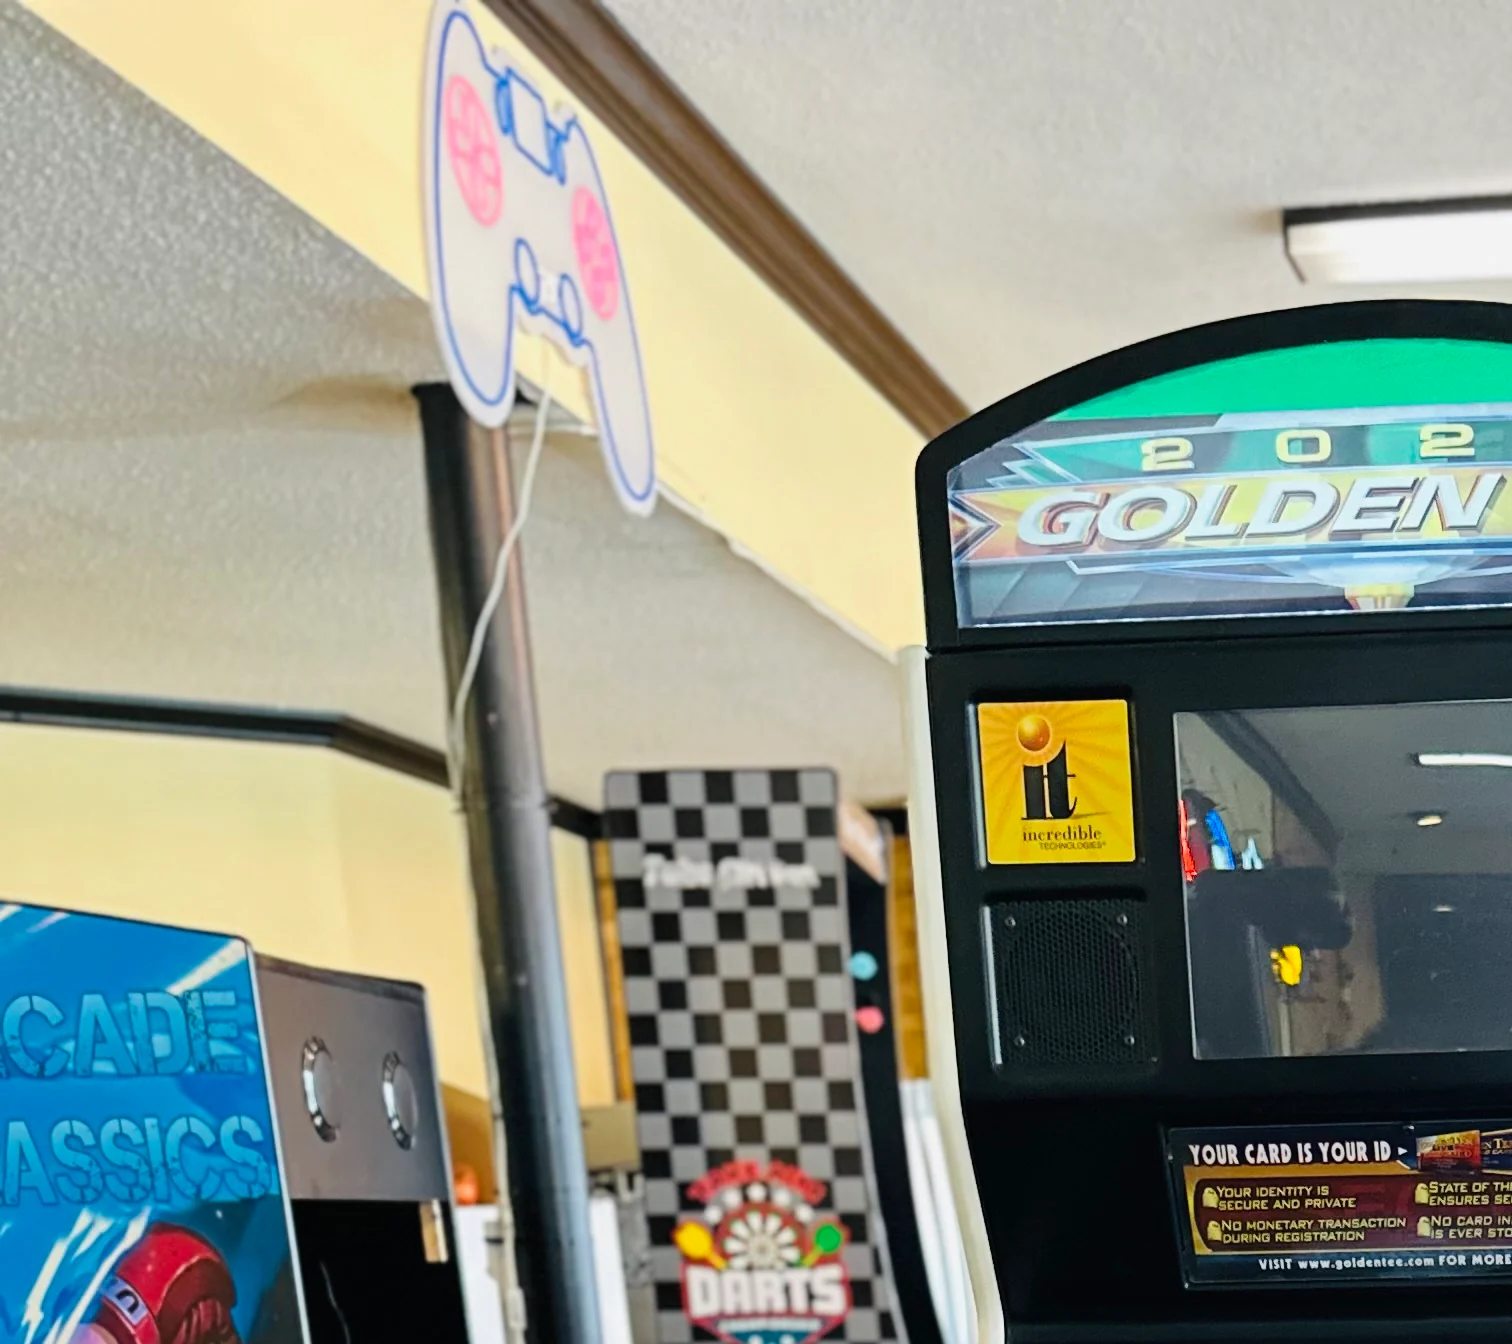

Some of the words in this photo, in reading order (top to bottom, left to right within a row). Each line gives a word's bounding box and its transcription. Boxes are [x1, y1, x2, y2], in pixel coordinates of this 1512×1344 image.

[1017, 471, 1512, 550] GOLDEN
[1023, 825, 1102, 842] incredible
[0, 989, 248, 1078] CADE
[1188, 1144, 1239, 1166] YOUR
[1244, 1143, 1291, 1164] CARD
[1298, 1143, 1312, 1164] IS
[1318, 1141, 1367, 1163] YOUR
[1374, 1141, 1391, 1162] ID
[1216, 1186, 1251, 1198] YOUR
[1256, 1186, 1312, 1197] IDENTITY
[1317, 1186, 1329, 1195] IS
[1429, 1182, 1467, 1193] STATE
[1472, 1181, 1489, 1192] OF
[1219, 1200, 1268, 1210] SECURE
[1273, 1199, 1300, 1209] AND
[1305, 1198, 1356, 1208] PRIVATE
[1429, 1195, 1489, 1206] ENSURES
[1222, 1220, 1241, 1231] NO
[1247, 1220, 1314, 1230] MONETARY
[1318, 1218, 1406, 1228] TRANSACTION
[1430, 1215, 1451, 1226] NO
[1457, 1215, 1493, 1226] CARD
[1223, 1233, 1270, 1243] DURING
[1276, 1231, 1365, 1242] REGISTRATION
[1431, 1229, 1443, 1239] IS
[1450, 1228, 1482, 1238] EVER
[1259, 1259, 1292, 1270] VISIT
[1298, 1256, 1434, 1270] www.goldentee.com
[1439, 1255, 1466, 1266] FOR
[1472, 1254, 1511, 1265] MORE
[685, 1264, 846, 1318] DARTS
